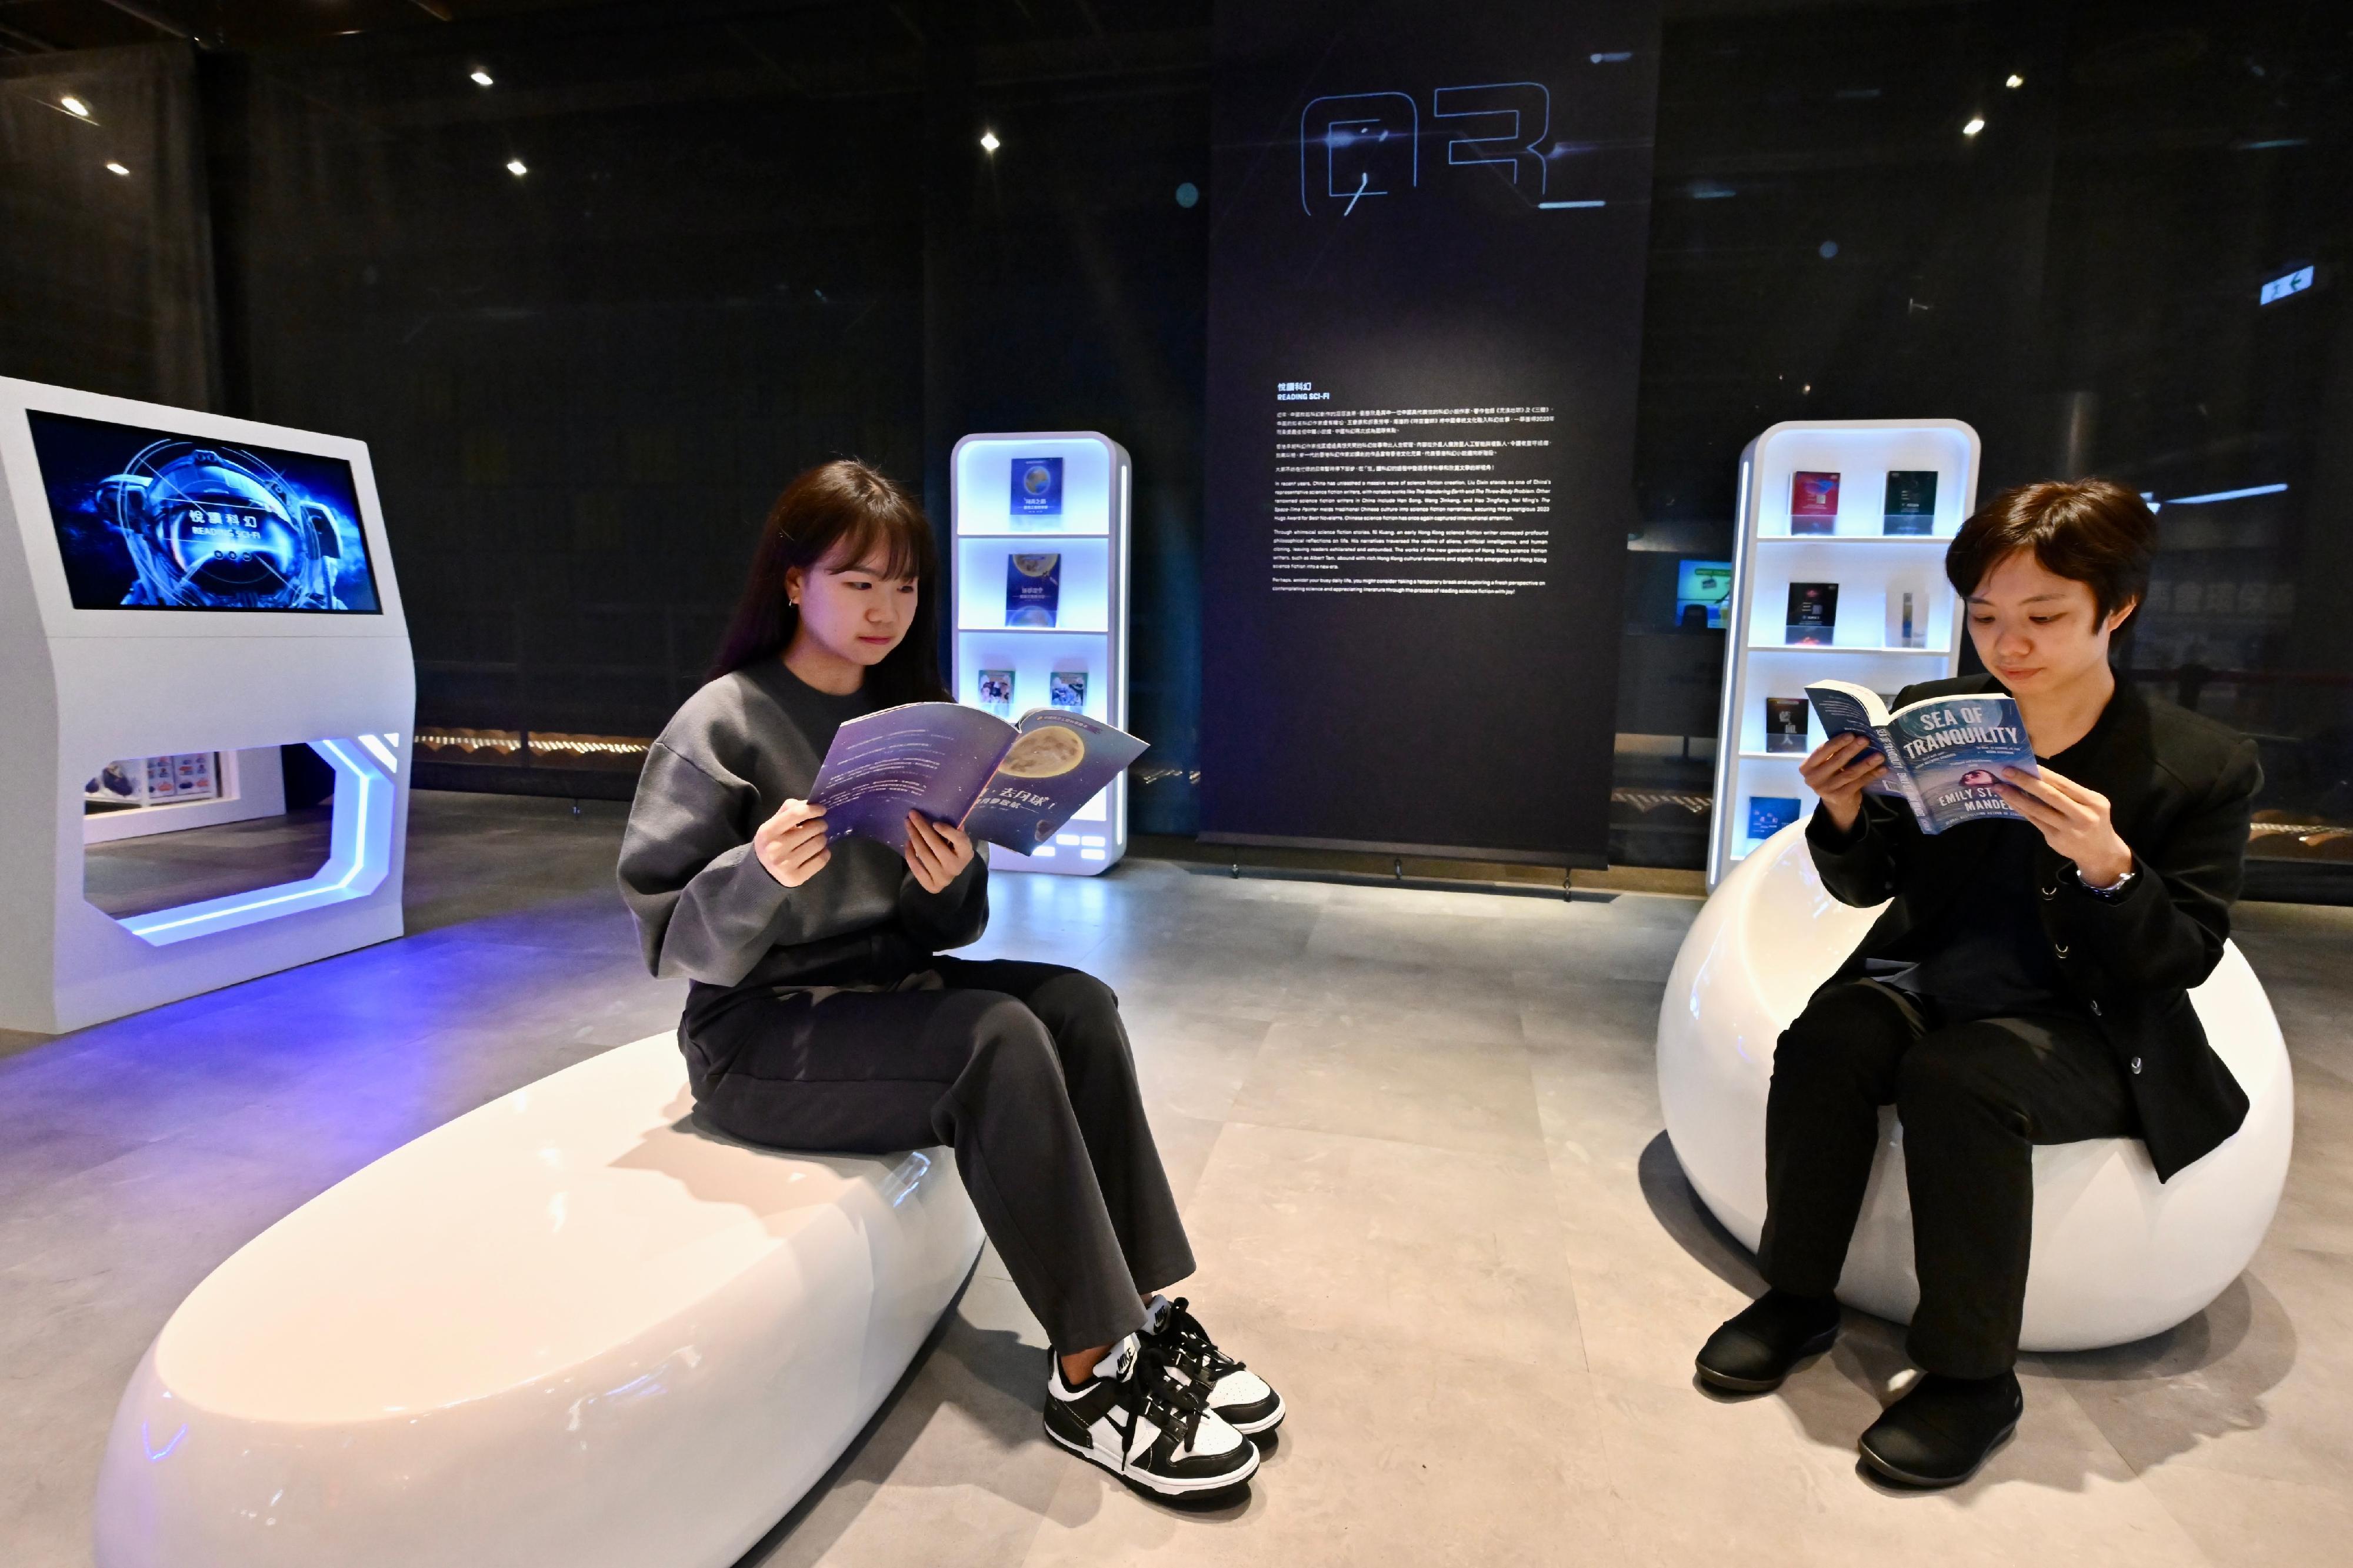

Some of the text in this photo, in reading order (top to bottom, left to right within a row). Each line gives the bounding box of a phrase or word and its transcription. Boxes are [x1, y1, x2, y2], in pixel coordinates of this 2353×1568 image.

[189, 509, 258, 528] 悅讀科幻
[192, 526, 261, 539] READING SCI-FI
[1920, 707, 1983, 730] SEA OF
[1903, 727, 2018, 759] TRANQUILITY
[1938, 787, 1998, 806] EMILY ST.
[1116, 1347, 1133, 1371] NIKE
